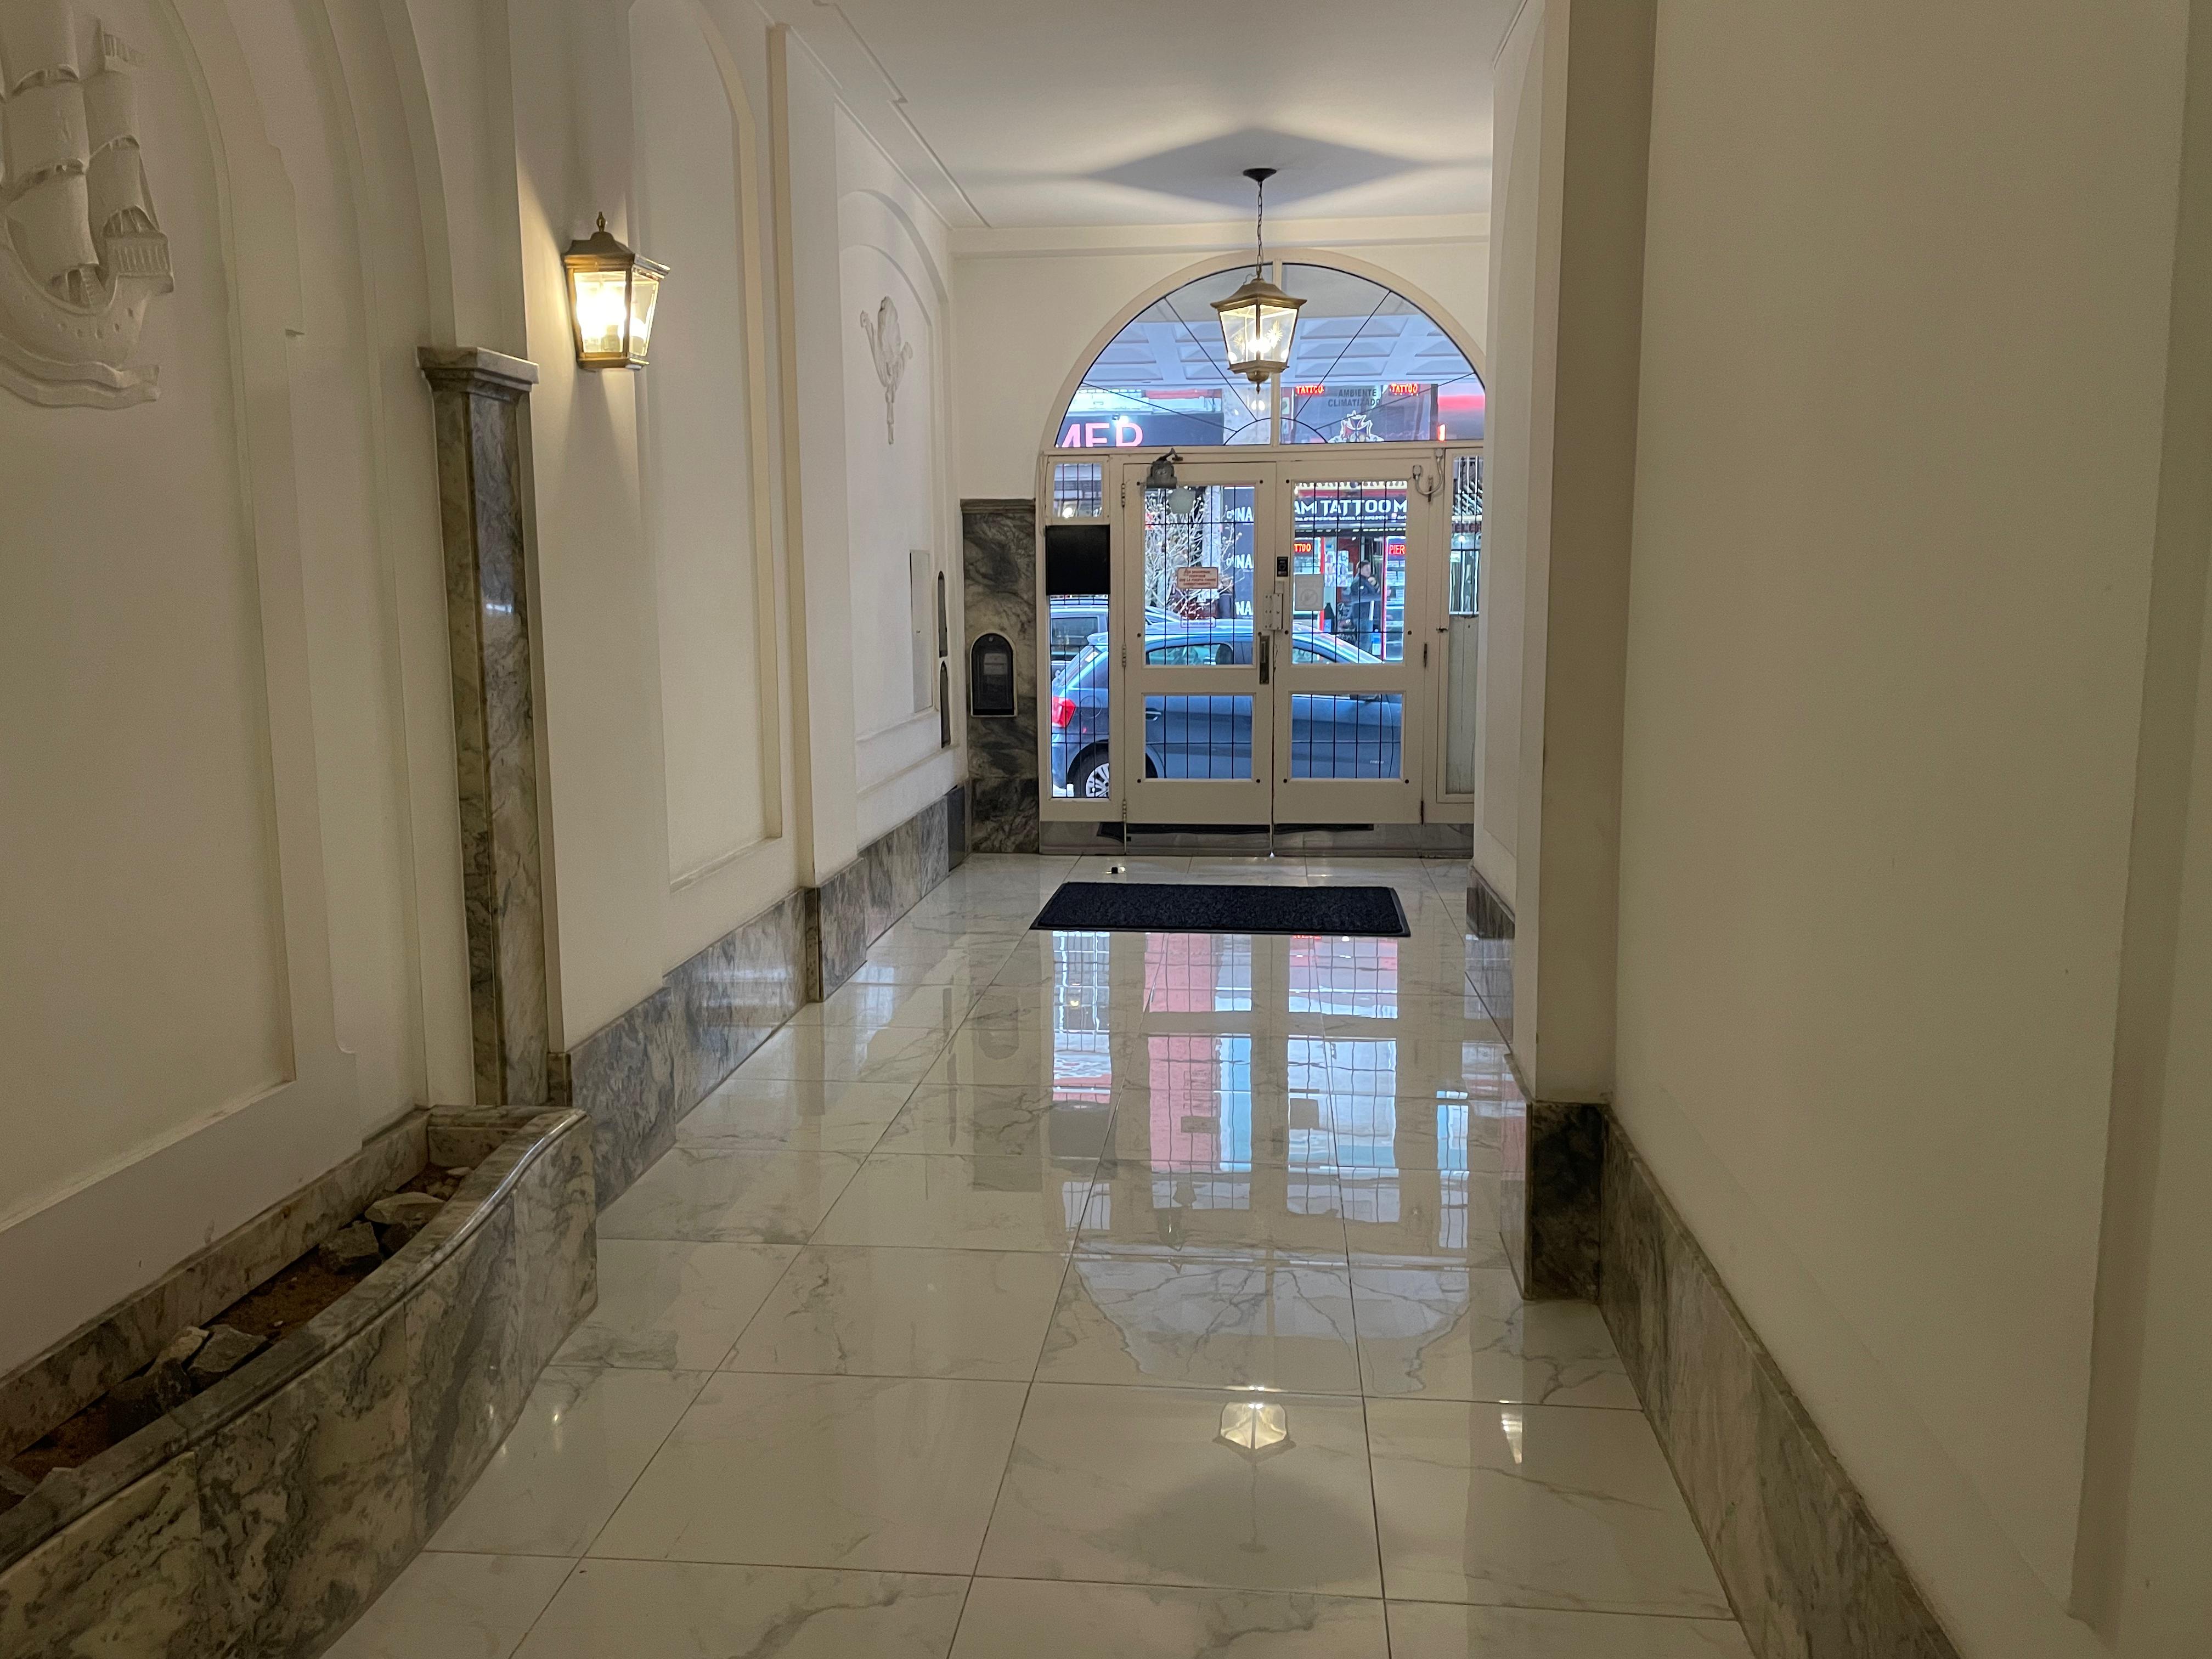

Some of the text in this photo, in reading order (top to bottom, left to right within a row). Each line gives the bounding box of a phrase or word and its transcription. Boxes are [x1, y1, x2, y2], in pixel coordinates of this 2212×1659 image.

[1338, 388, 1376, 397] AMBIENTE
[1391, 383, 1418, 393] TATTOO
[1328, 398, 1380, 407] CLIMATIZADO
[1320, 499, 1391, 516] TATTOO
